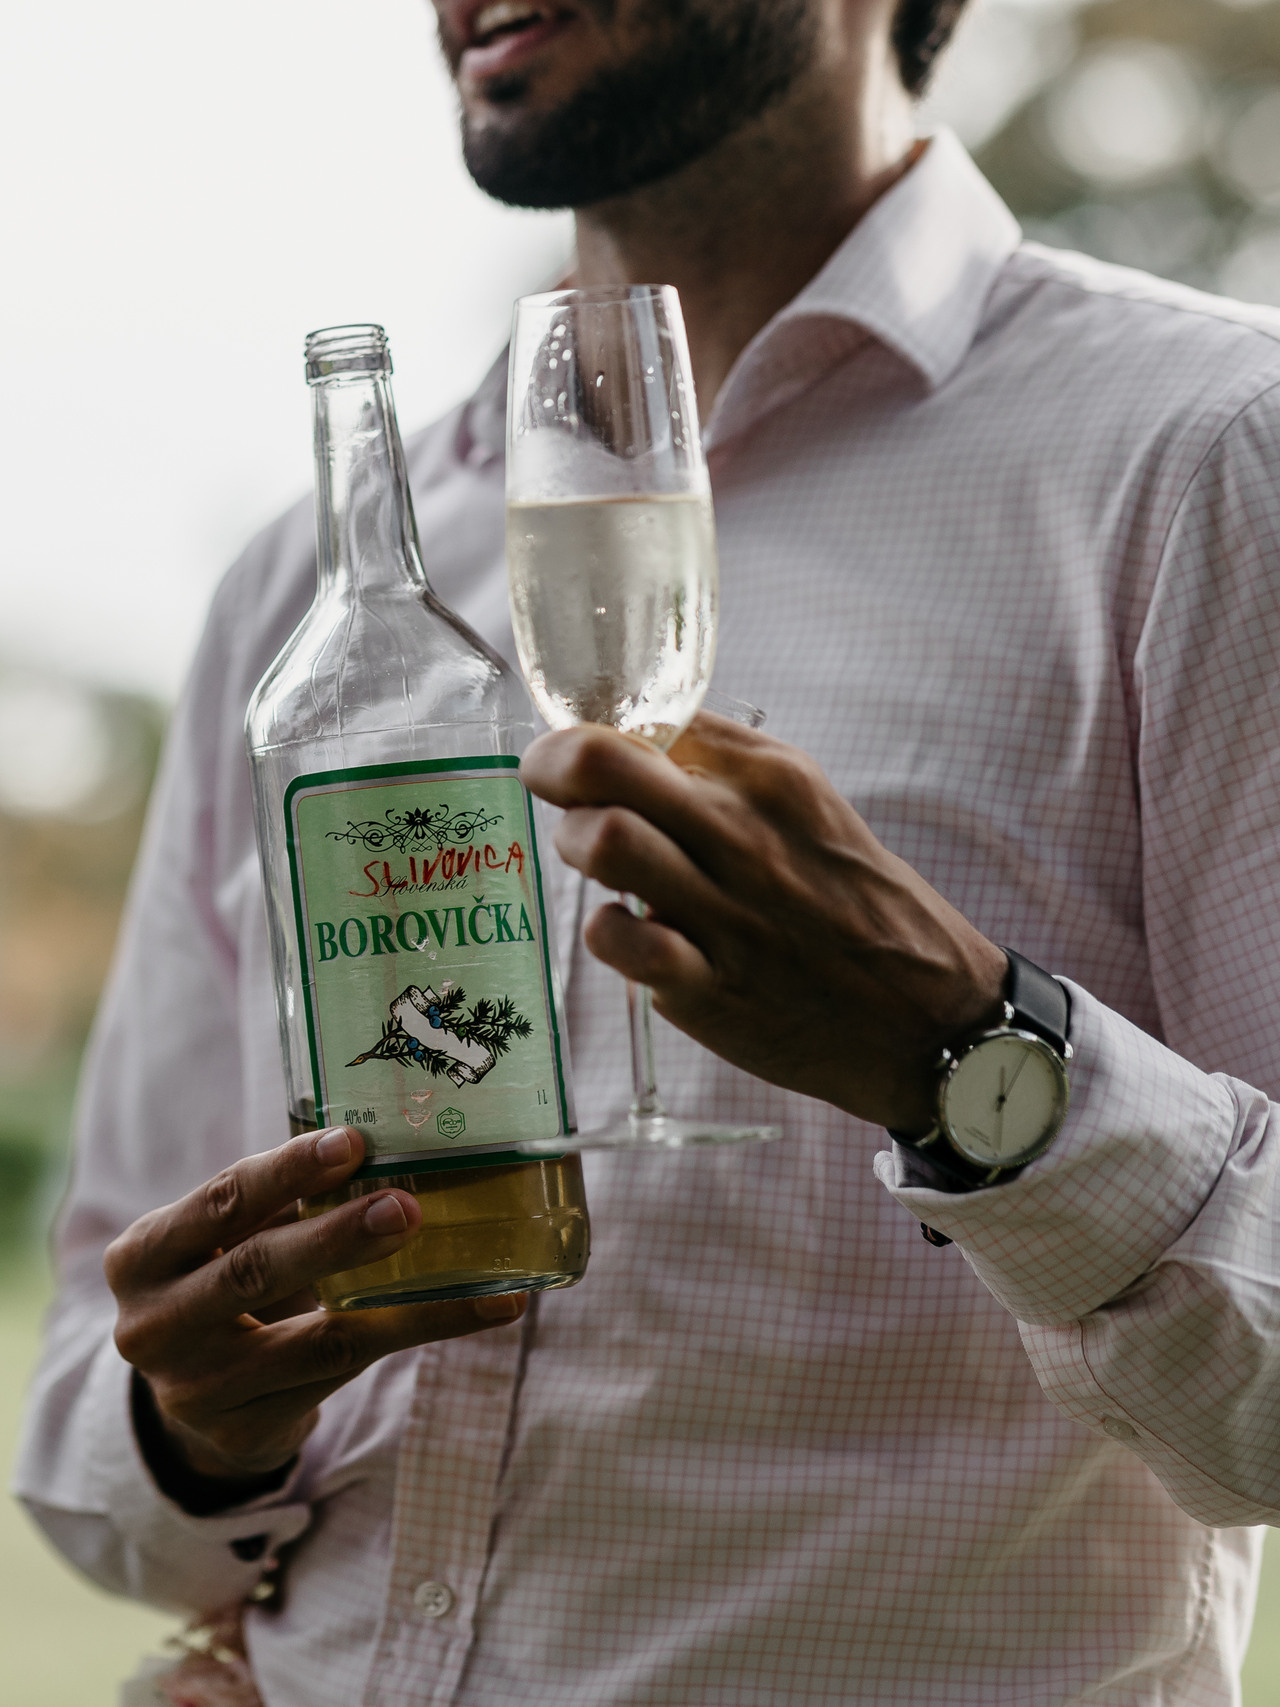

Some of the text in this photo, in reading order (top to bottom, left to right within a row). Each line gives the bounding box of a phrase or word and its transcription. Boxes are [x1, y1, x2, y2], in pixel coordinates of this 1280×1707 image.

[374, 872, 469, 897] Slovenská
[315, 895, 535, 962] BOROVIČKA
[344, 1107, 378, 1125] 40% obj.
